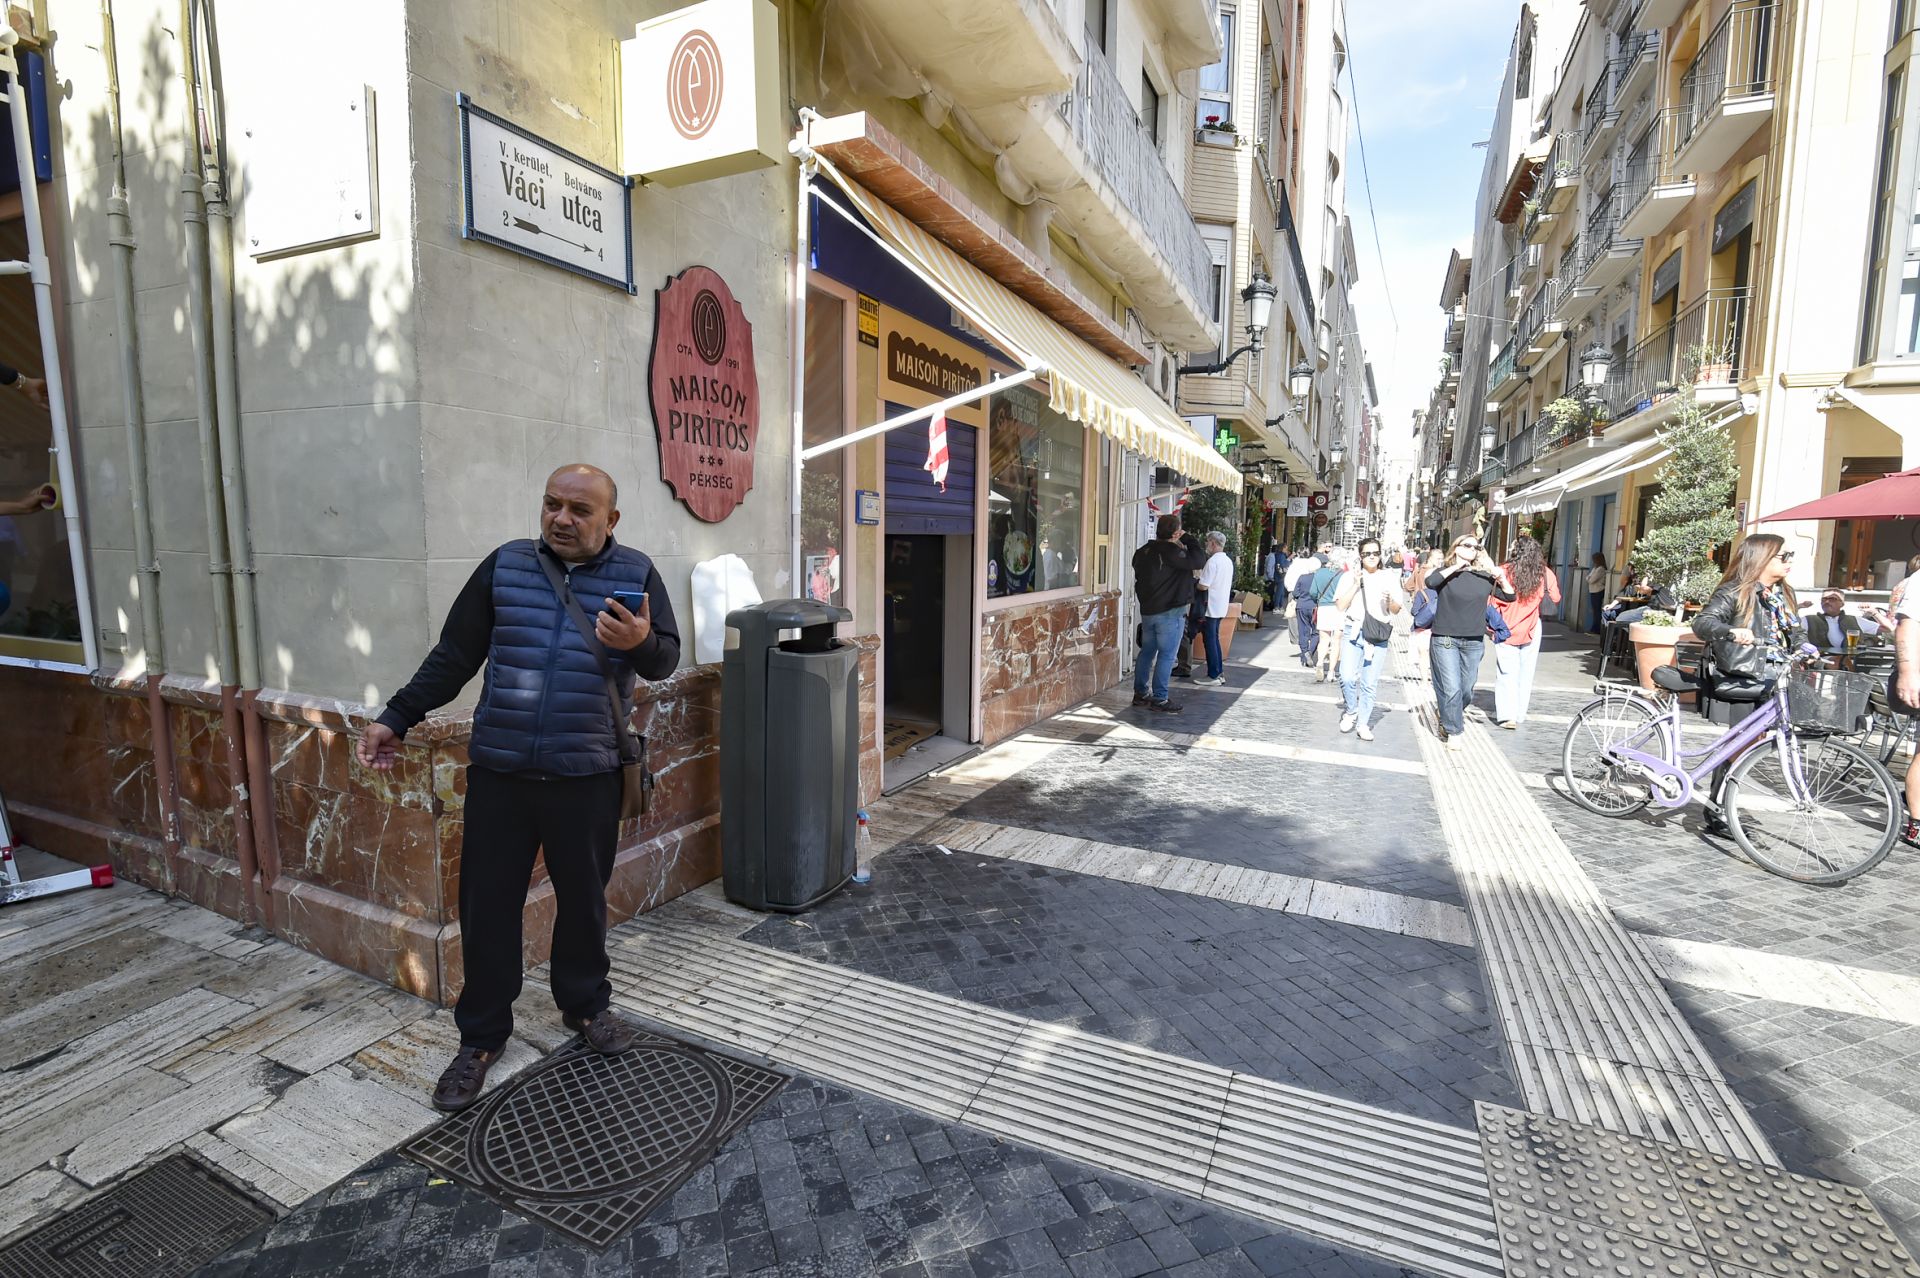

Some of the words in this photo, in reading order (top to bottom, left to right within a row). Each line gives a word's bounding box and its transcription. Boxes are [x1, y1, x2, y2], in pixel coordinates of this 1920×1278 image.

[499, 140, 509, 158] V.
[514, 147, 552, 179] kerület,
[564, 172, 603, 201] Belváros
[500, 160, 546, 210] Váci
[561, 195, 603, 233] utca
[503, 210, 509, 227] 2
[598, 248, 603, 262] 4
[725, 357, 740, 370] 1991
[896, 350, 939, 387] MAISON
[670, 375, 747, 418] MAISON
[690, 469, 733, 490] PÉKSÉG
